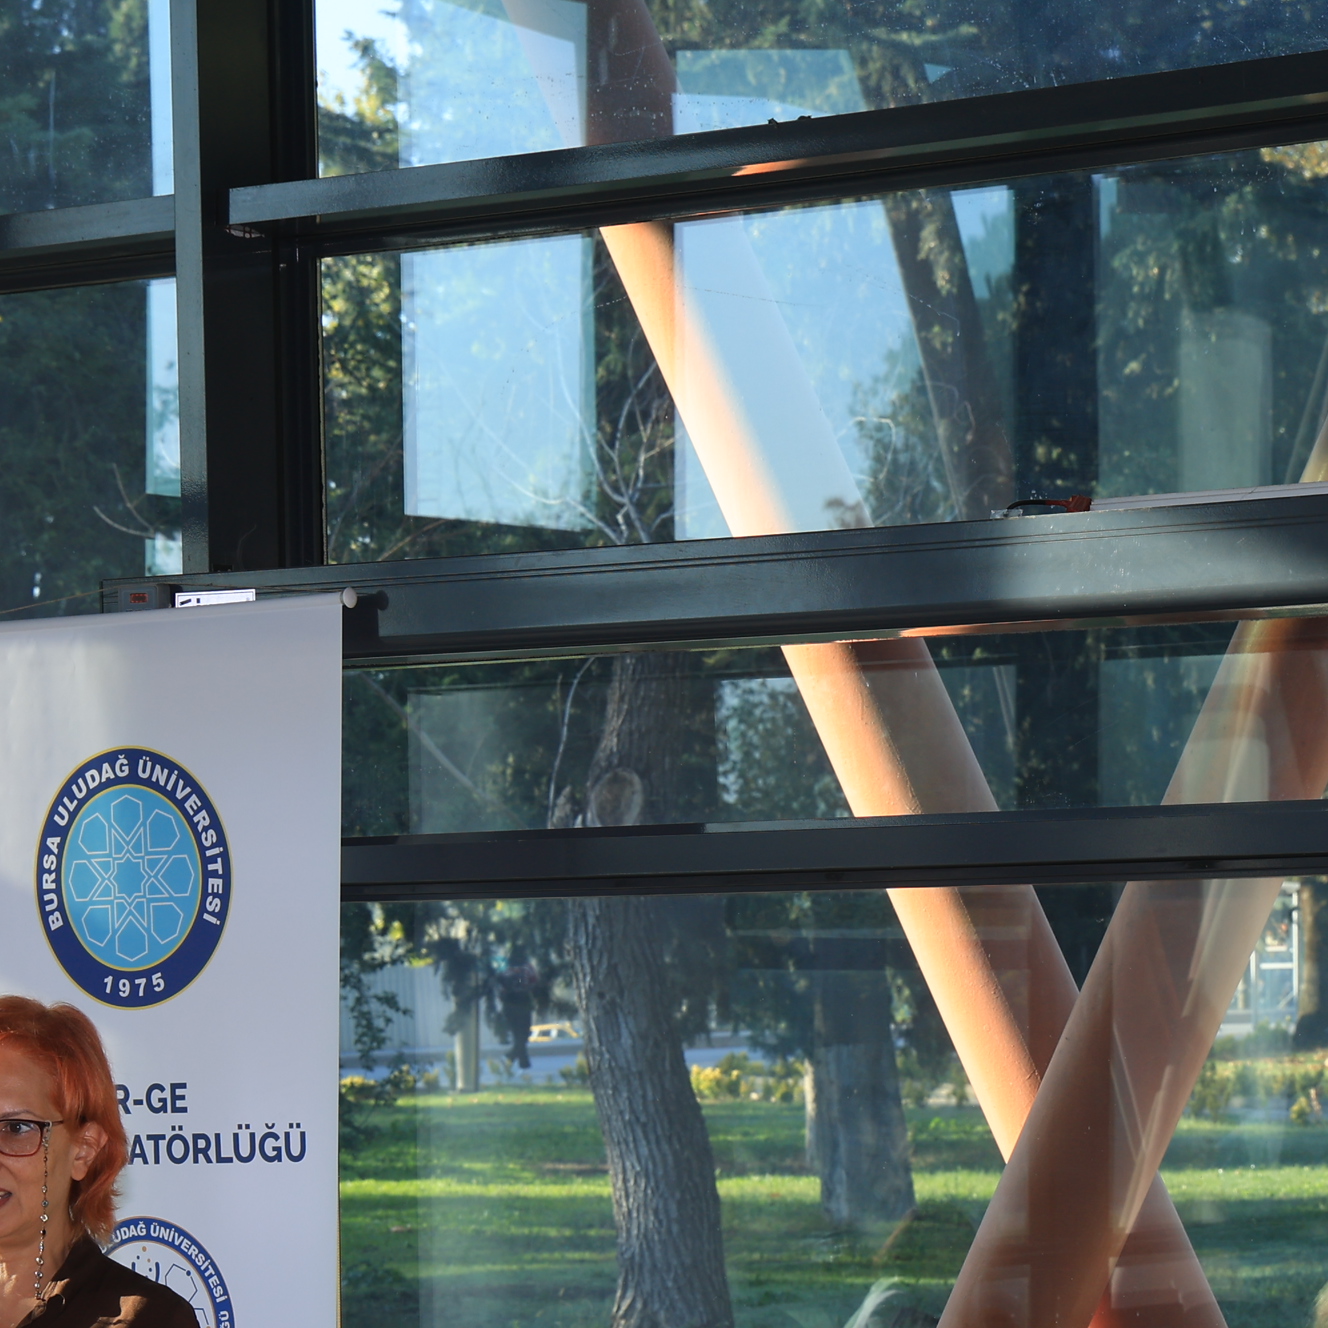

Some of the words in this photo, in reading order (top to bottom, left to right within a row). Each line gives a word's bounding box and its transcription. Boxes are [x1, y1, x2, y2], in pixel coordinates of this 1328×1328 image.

[42, 836, 63, 931] BURSA
[53, 754, 130, 827] ULUDAĞ
[137, 755, 223, 927] ÜNİVERSİTESİ
[103, 972, 165, 998] 1975
[116, 1082, 188, 1115] R-GE
[128, 1122, 307, 1165] ATÖRLÜĞÜ
[150, 1222, 228, 1303] ÜNİVERSİTESİ
